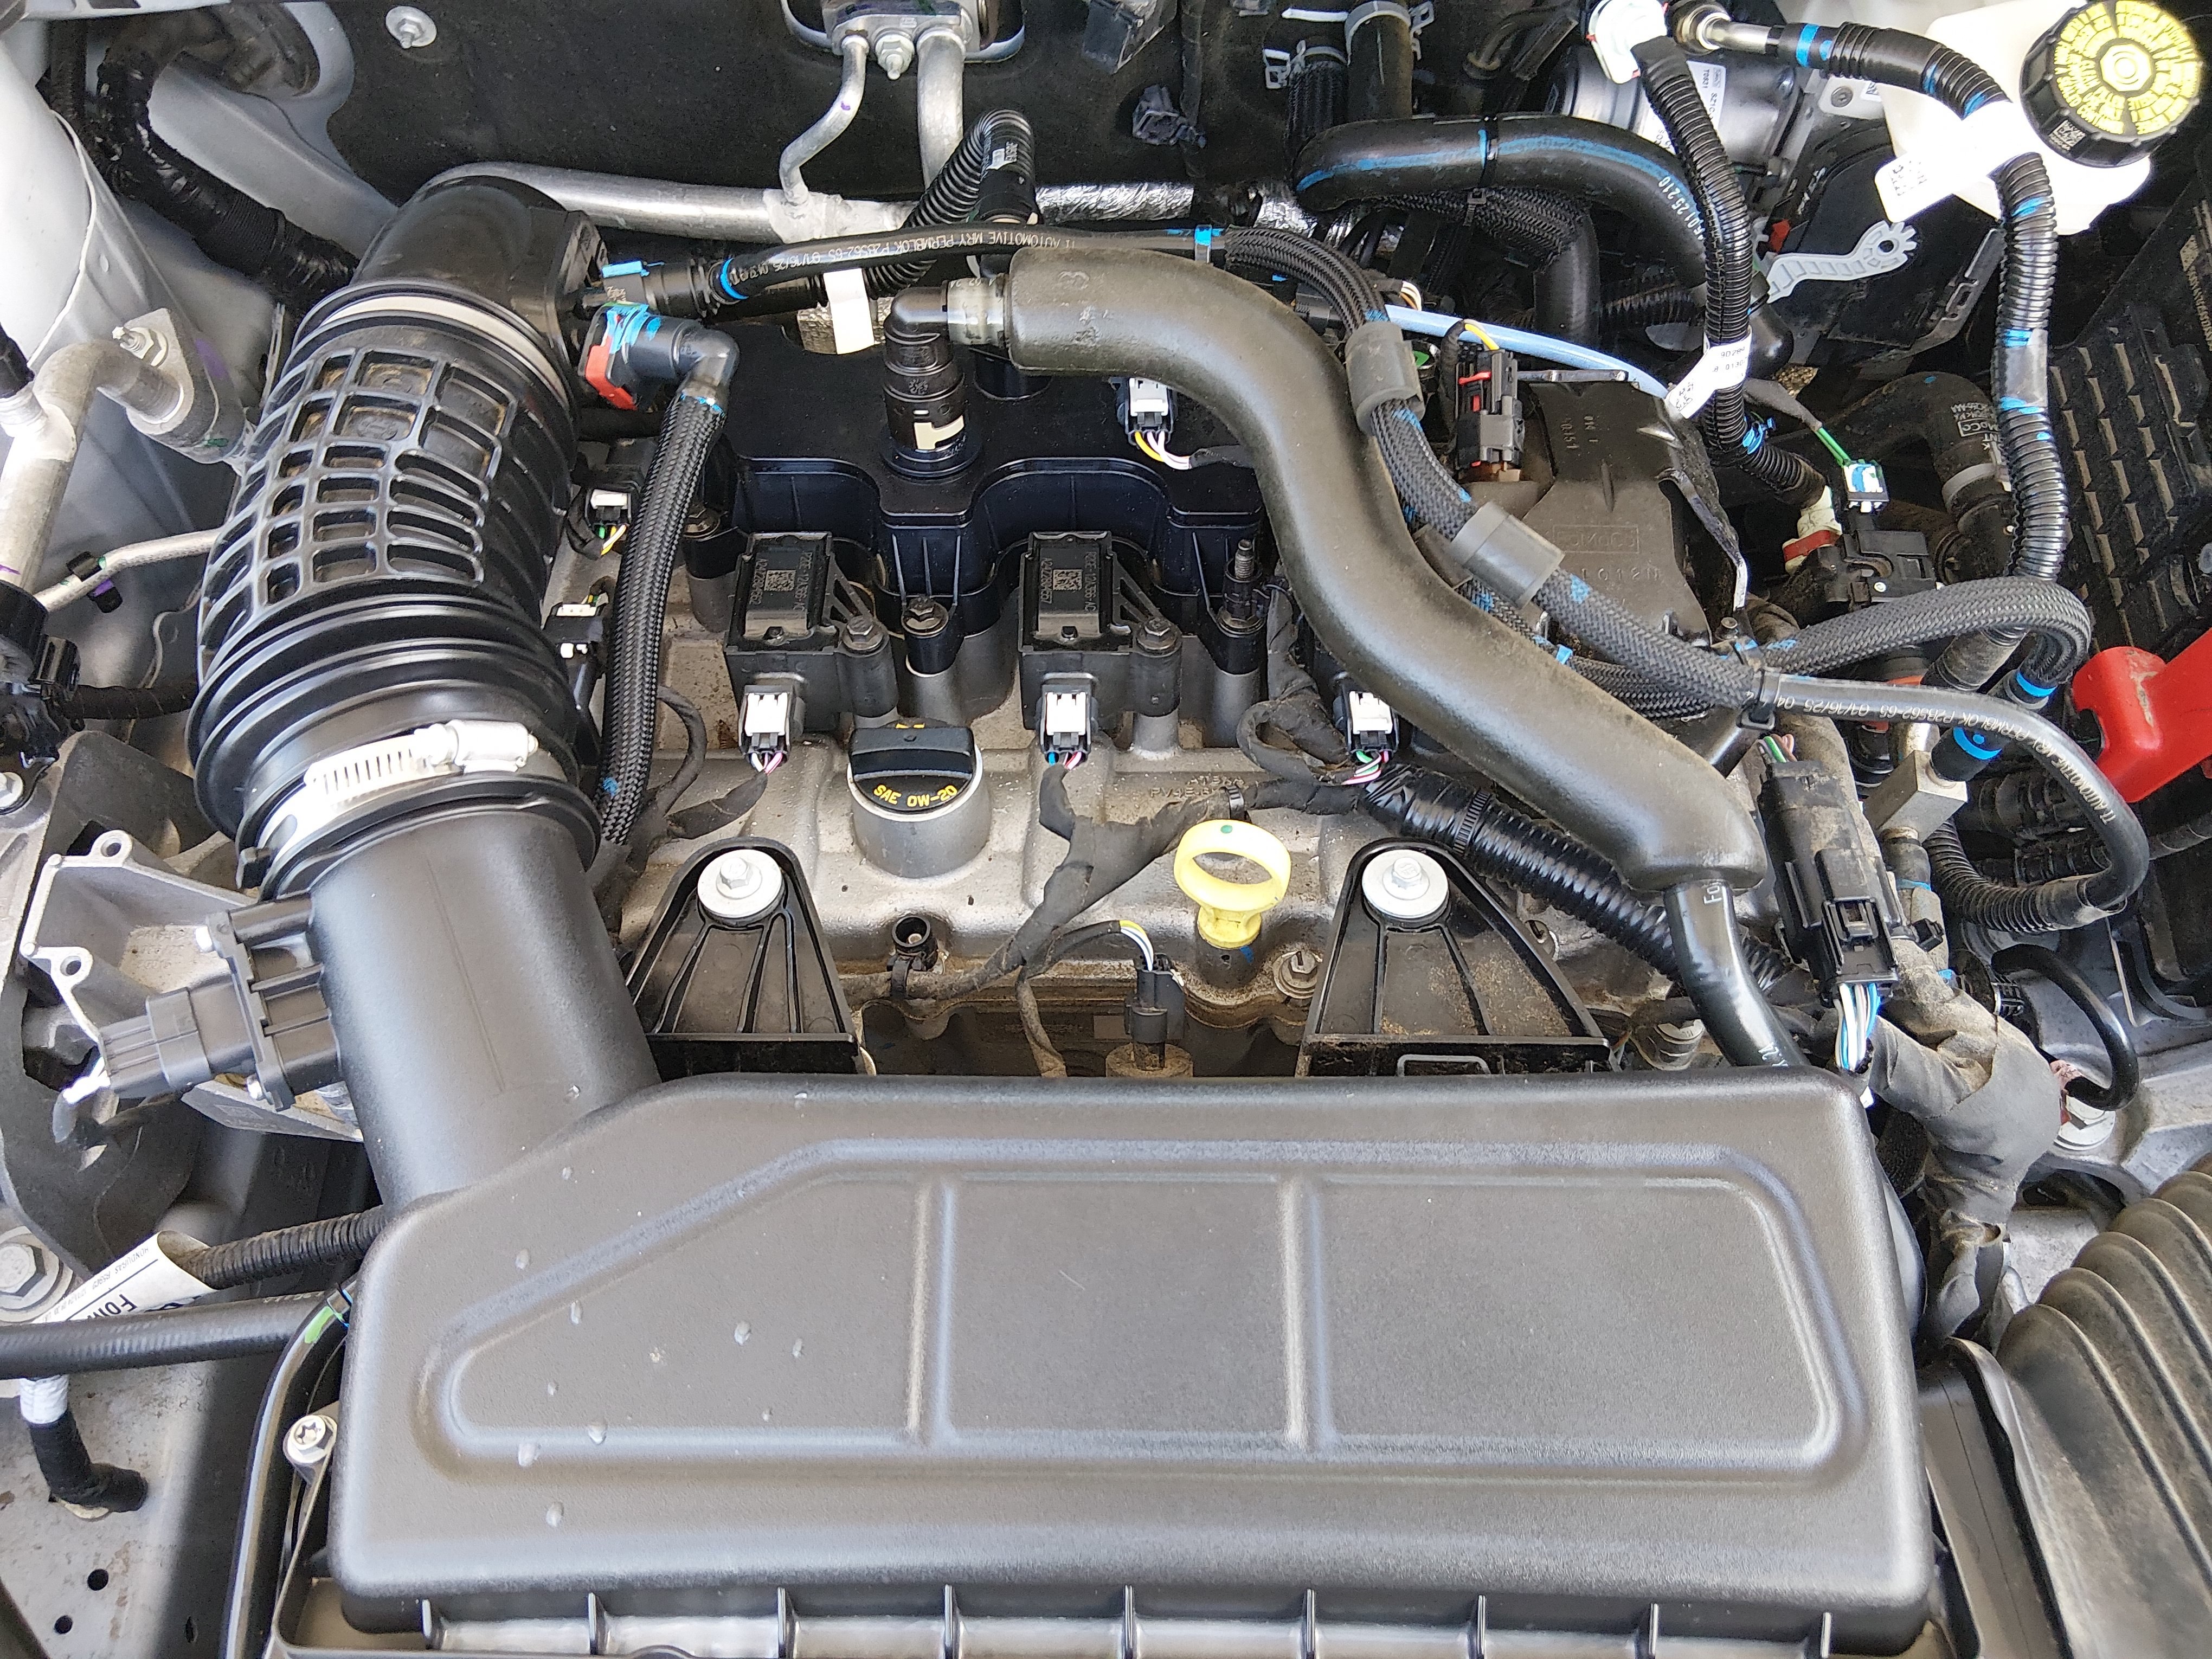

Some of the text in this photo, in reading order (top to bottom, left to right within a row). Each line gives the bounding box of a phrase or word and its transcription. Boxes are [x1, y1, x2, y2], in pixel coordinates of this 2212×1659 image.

[988, 231, 1061, 249] AUTOMOTIVE
[873, 784, 959, 808] SAE 0W-20
[2050, 757, 2108, 811] AUTOMOTIVE
